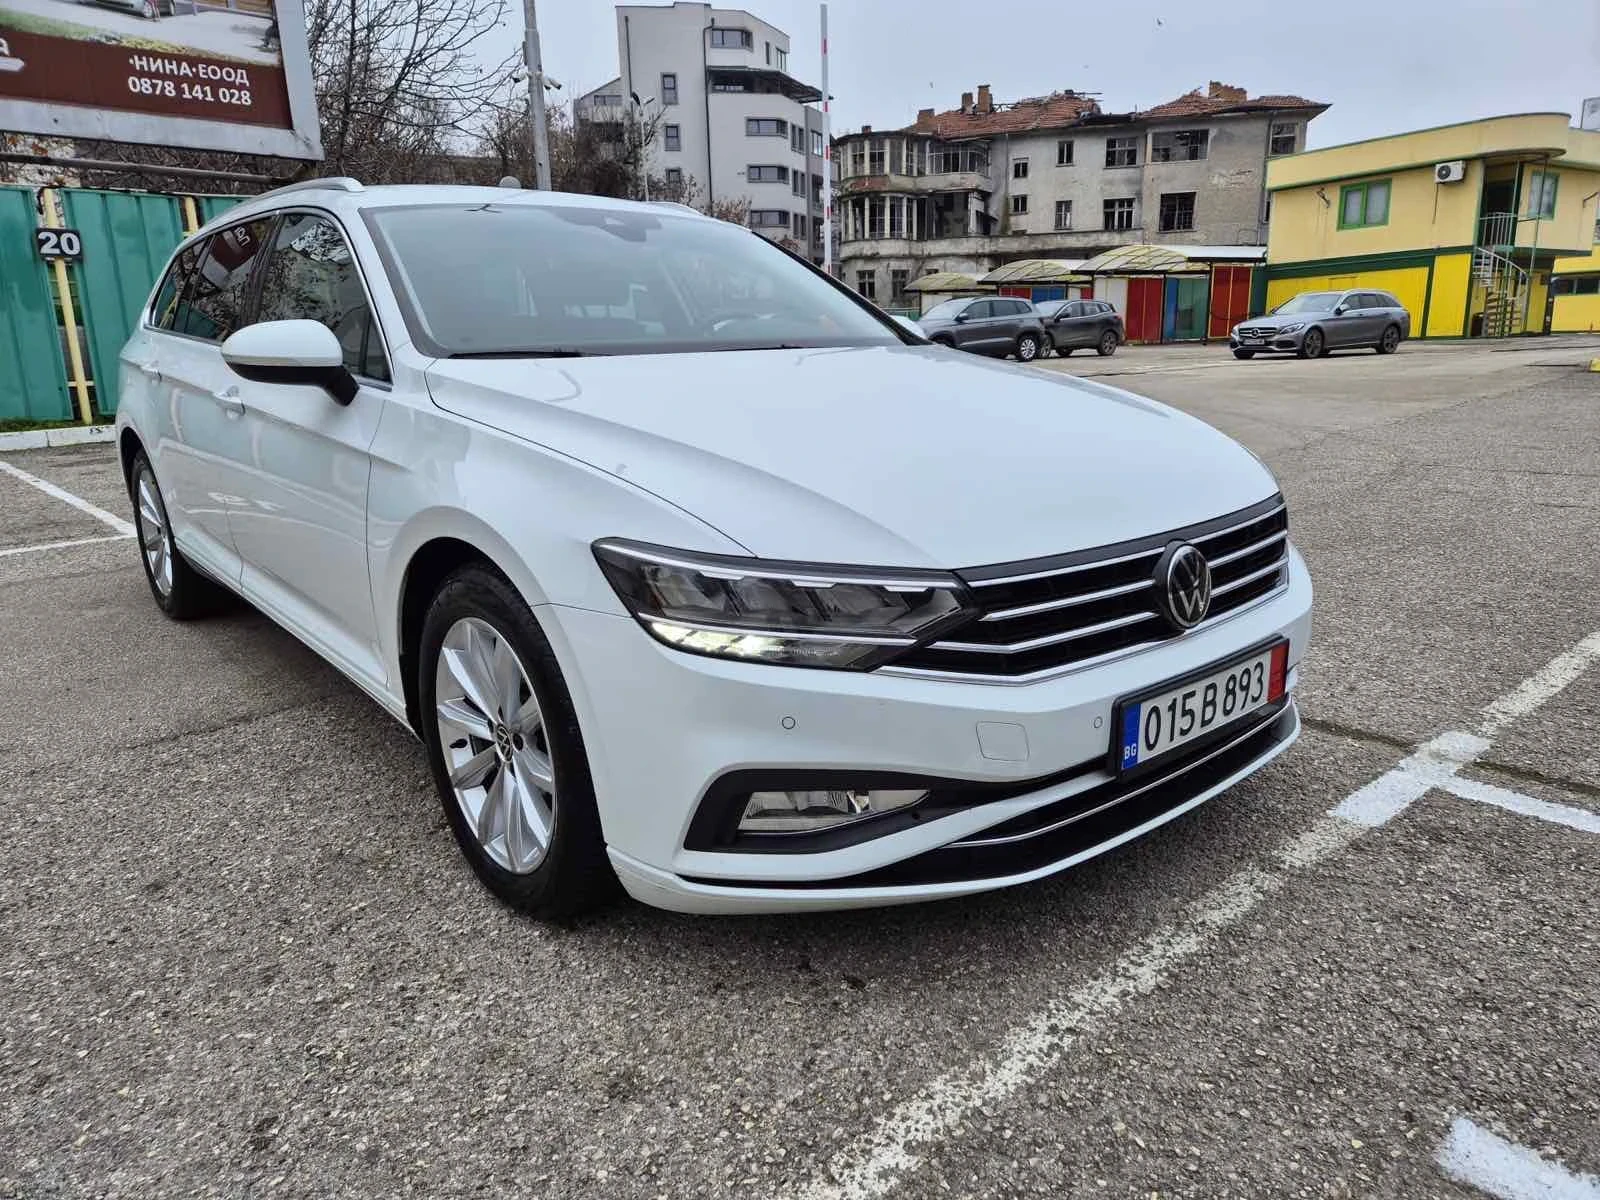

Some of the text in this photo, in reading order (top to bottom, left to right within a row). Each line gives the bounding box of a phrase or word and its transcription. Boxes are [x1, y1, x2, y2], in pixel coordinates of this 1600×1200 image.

[128, 76, 252, 105] 0878 141 028
[38, 231, 81, 256] 20
[1124, 743, 1137, 760] BG
